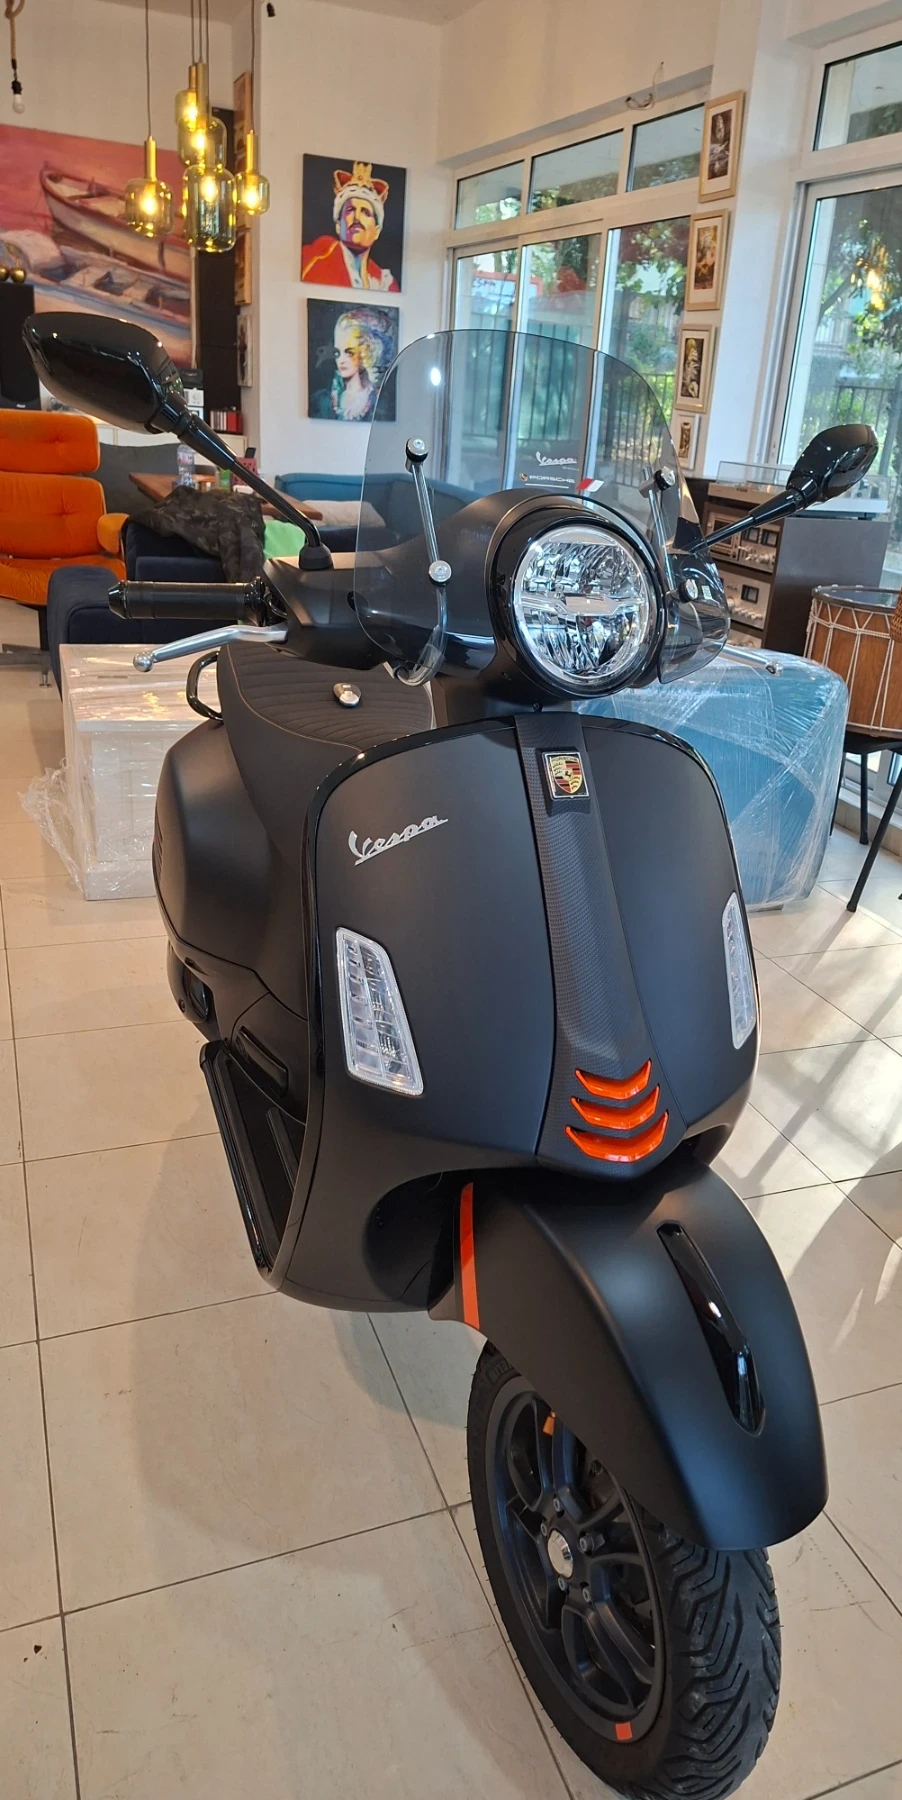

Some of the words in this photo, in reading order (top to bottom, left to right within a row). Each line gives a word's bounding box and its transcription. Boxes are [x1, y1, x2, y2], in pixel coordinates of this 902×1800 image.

[535, 451, 577, 466] Vespa
[529, 475, 576, 484] PORSCHE
[348, 815, 449, 866] Vespa
